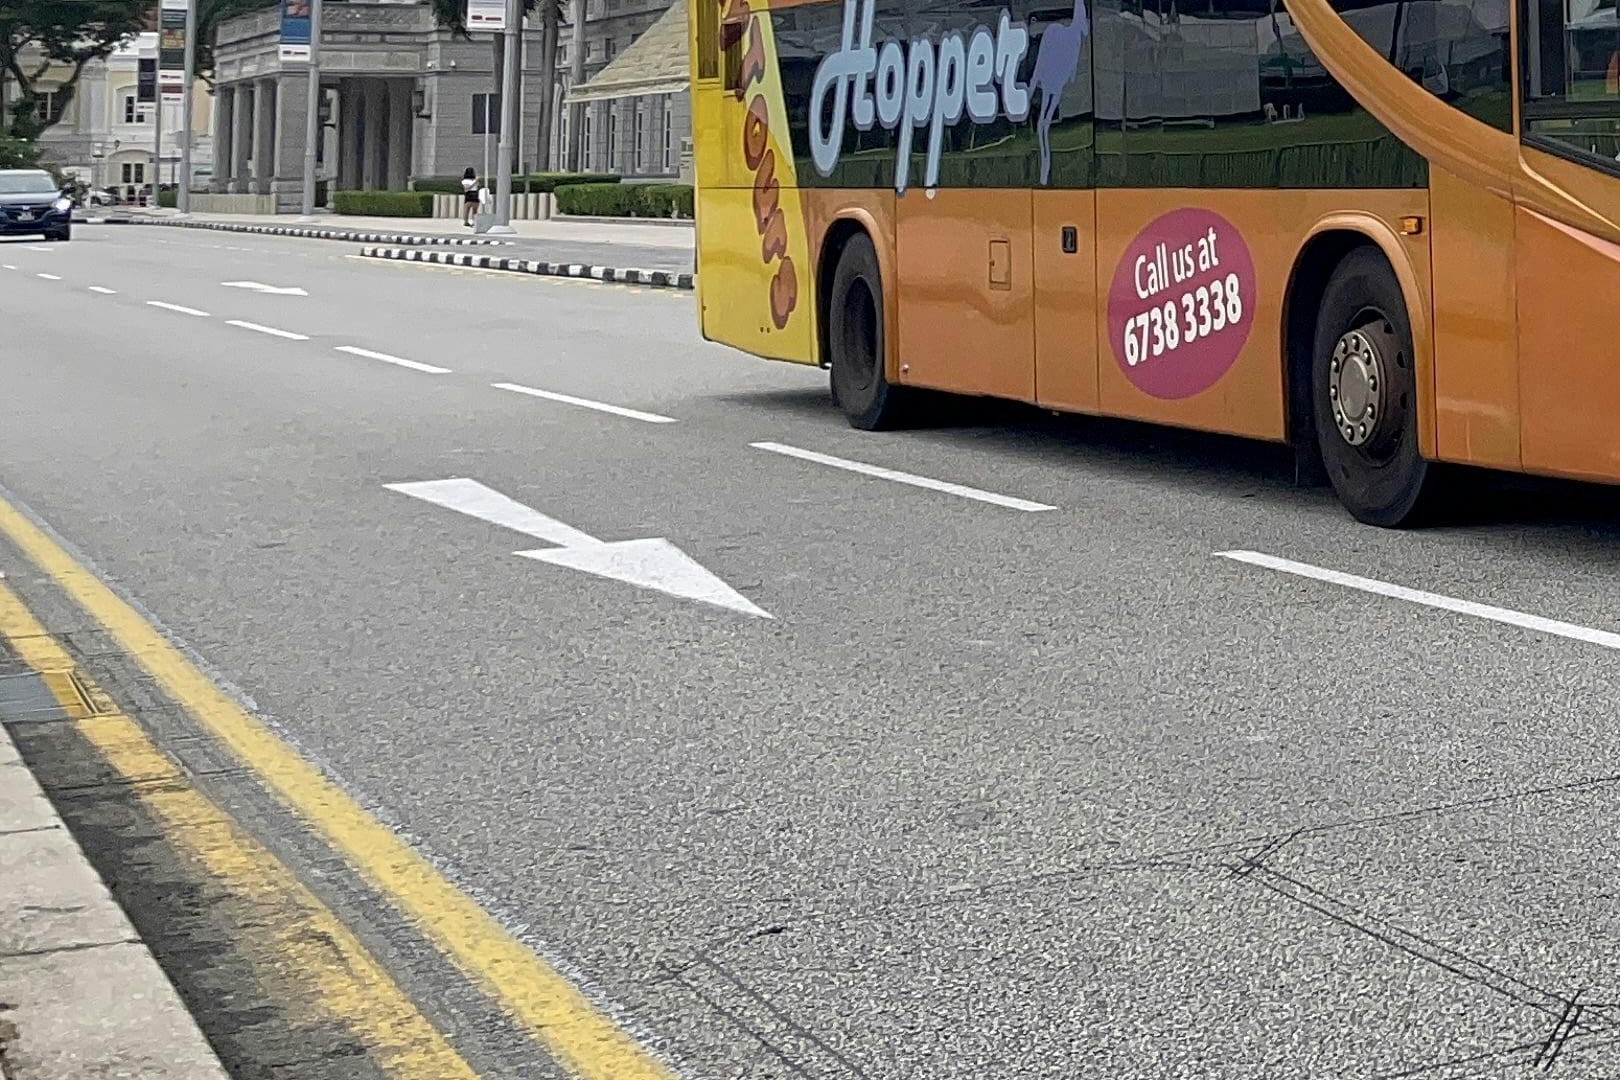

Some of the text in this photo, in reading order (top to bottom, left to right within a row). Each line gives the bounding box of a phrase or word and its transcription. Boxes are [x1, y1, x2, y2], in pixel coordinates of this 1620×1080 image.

[1135, 226, 1219, 299] Call us at
[1124, 273, 1242, 366] 6738 3338
